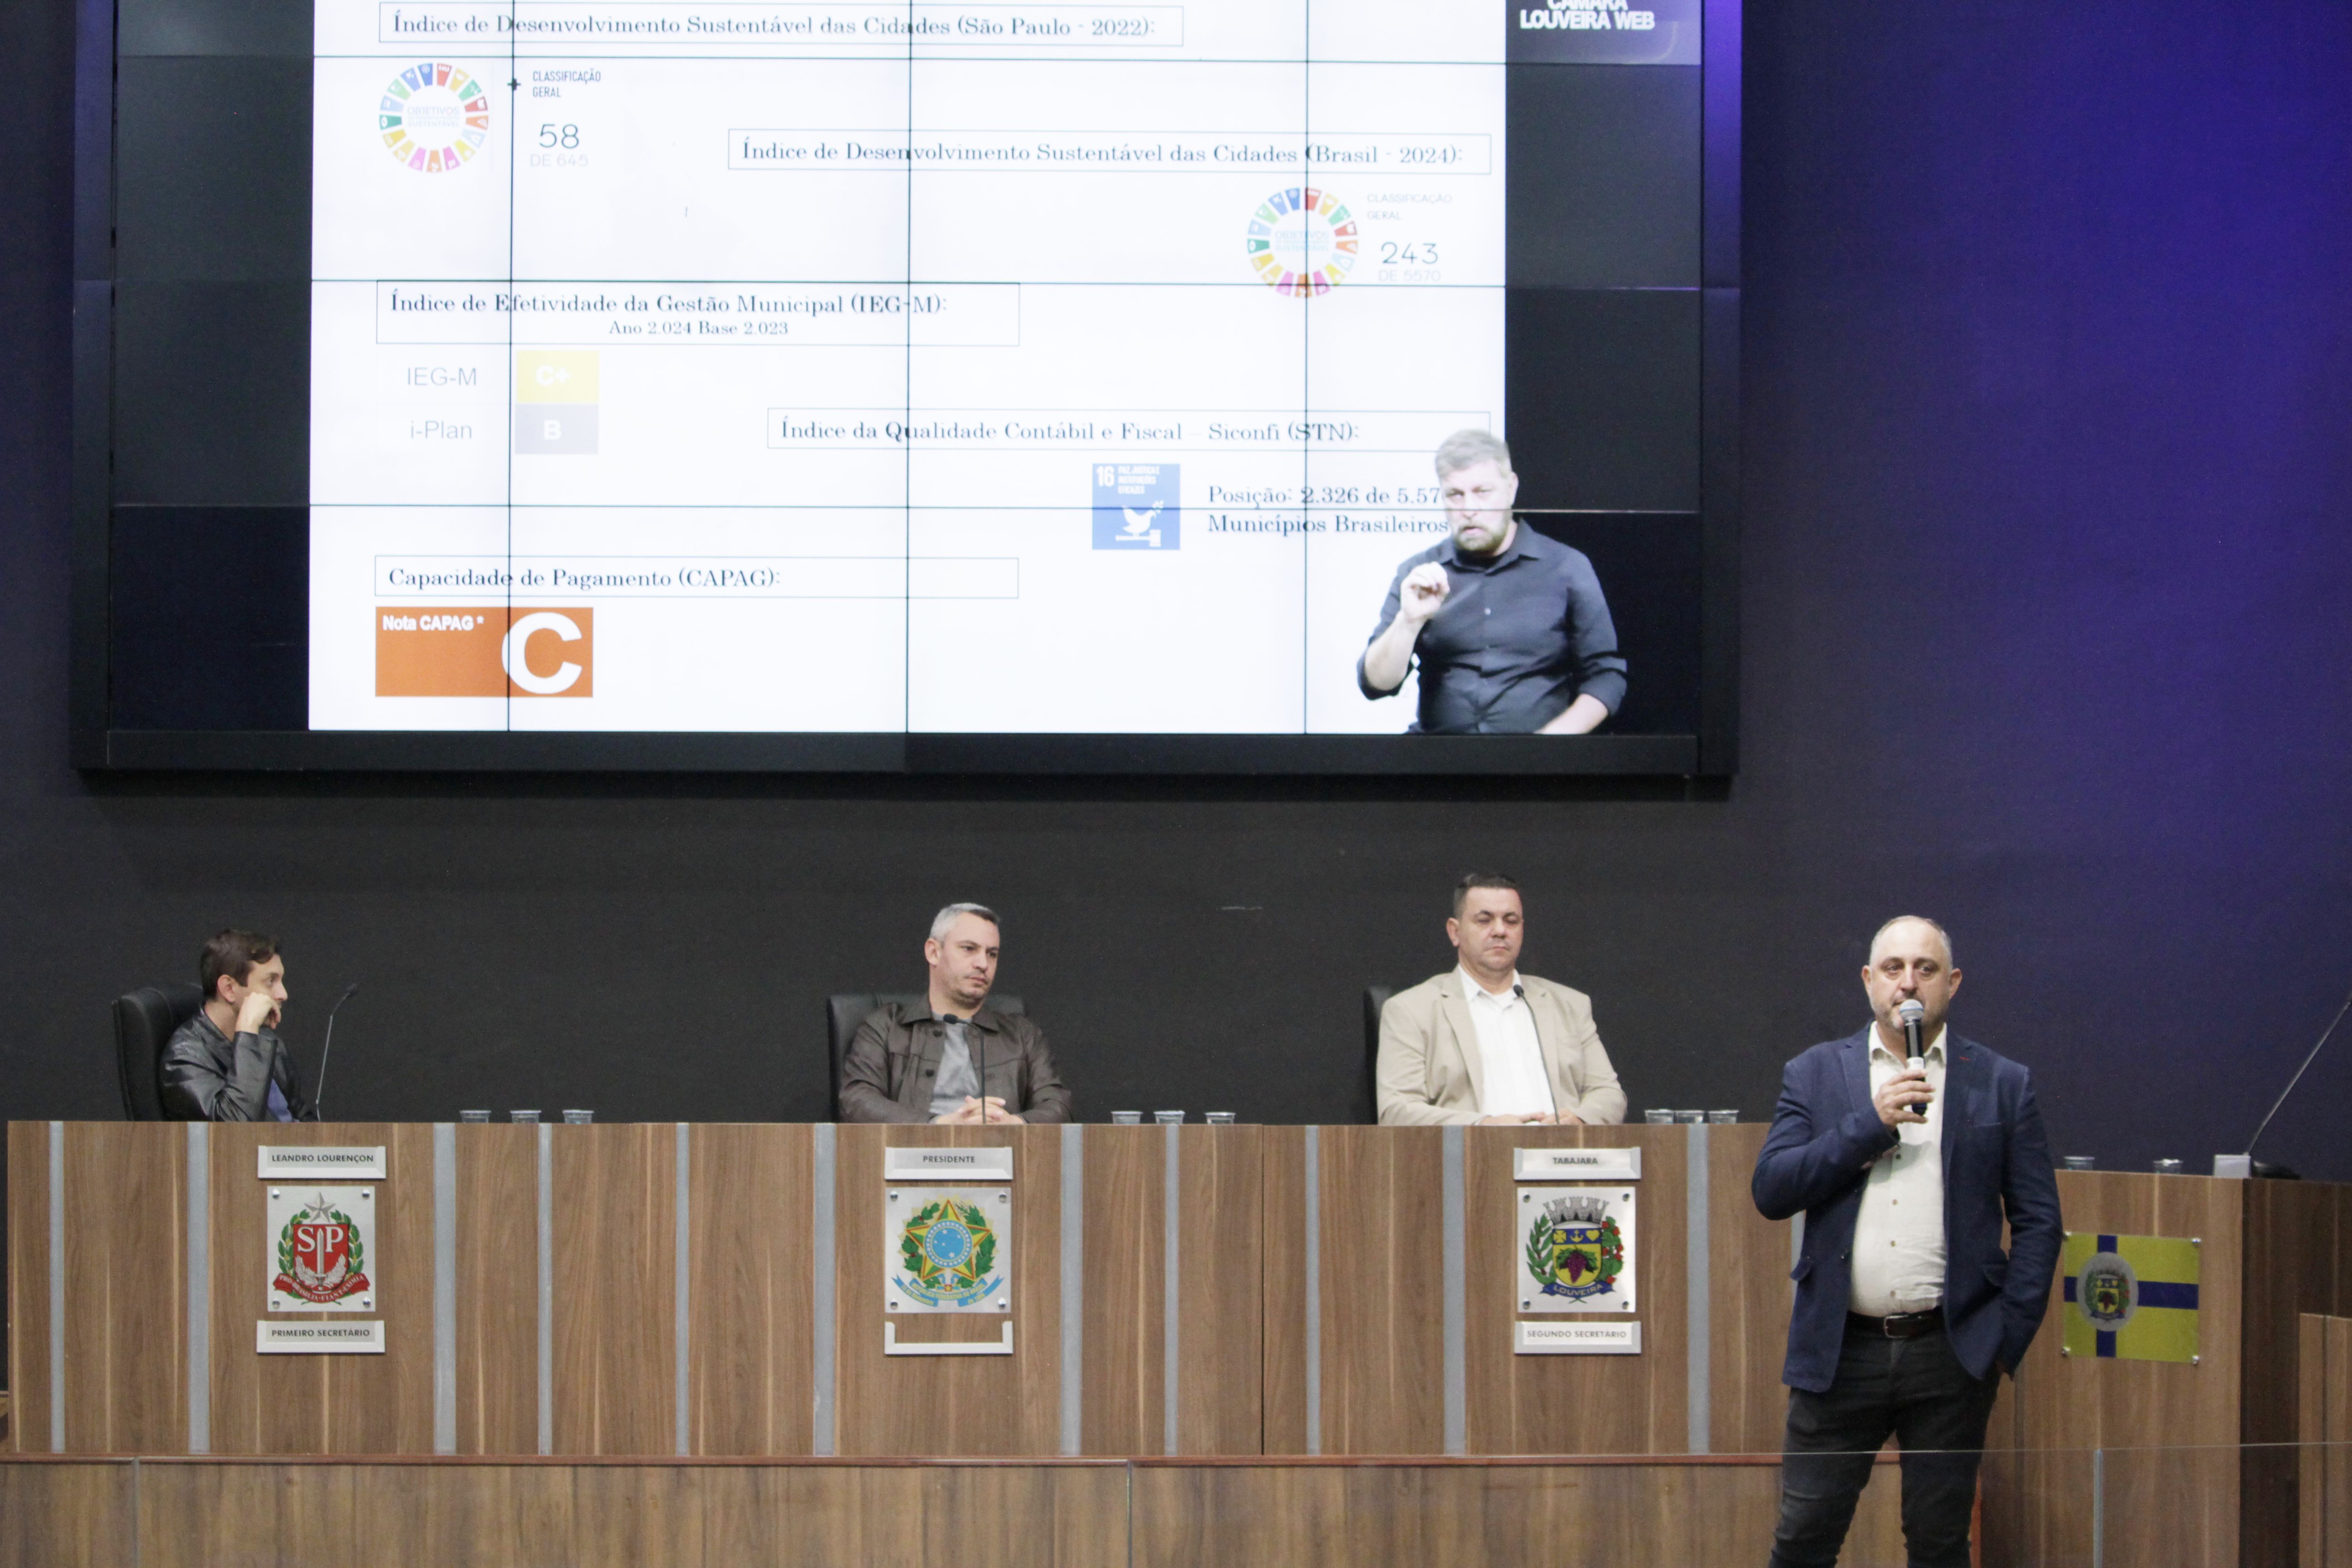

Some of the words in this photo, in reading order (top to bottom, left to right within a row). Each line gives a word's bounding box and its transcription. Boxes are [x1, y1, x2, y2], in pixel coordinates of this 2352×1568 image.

[394, 9, 458, 33] Índice
[465, 15, 489, 33] de
[496, 15, 680, 33] Desenvolvimento
[687, 15, 812, 33] Sustentável
[821, 16, 856, 33] das
[864, 16, 950, 34] Cidades
[957, 15, 1003, 35] (São
[1012, 18, 1071, 35] Paulo
[1092, 18, 1155, 36] 2022):
[1520, 10, 1611, 29] LOUVEIRA
[1614, 11, 1655, 30] WEB
[533, 68, 601, 84] CLASSIFICAÇÃO
[533, 86, 561, 98] GERAL
[539, 123, 579, 149] 58
[530, 153, 551, 167] DE
[557, 153, 588, 167] 645
[743, 136, 807, 159] Índice
[814, 142, 838, 159] de
[847, 142, 1030, 161] Desenvolvimento
[1037, 143, 1162, 162] Sustentável
[1170, 144, 1205, 162] das
[1213, 144, 1298, 162] Cidades
[1305, 144, 1377, 163] (Brasil
[1400, 145, 1462, 165] 2024):
[1367, 193, 1453, 205] CLASSIFICAÇÃO
[1367, 210, 1401, 220] GERAL
[1276, 230, 1329, 239] OBJETVOS
[1381, 241, 1438, 265] 243
[1378, 269, 1398, 282] DE
[1404, 270, 1441, 282] 5570
[392, 288, 456, 312] Índice
[462, 294, 486, 312] de
[495, 294, 617, 313] Efetividade
[624, 294, 648, 312] da
[657, 295, 730, 312] Gestão
[737, 295, 843, 317] Municipal
[851, 293, 947, 314] (IEG-M):
[609, 320, 642, 334] Ano
[648, 321, 692, 335] 2.024
[699, 321, 738, 335] Base
[744, 322, 789, 335] 2.023
[407, 367, 477, 386] IEG-M
[535, 366, 570, 387] C+
[411, 420, 472, 439] i-Plan
[544, 420, 562, 440] B
[783, 416, 846, 438] Índice
[853, 421, 877, 438] da
[885, 421, 997, 442] Qualidade
[1004, 421, 1093, 440] Contábil
[1102, 429, 1112, 439] e
[1122, 422, 1181, 440] Fiscal
[1209, 422, 1279, 441] Siconfi
[1288, 422, 1359, 443] (STN):
[1096, 466, 1115, 487] 16
[1209, 485, 1292, 509] Posição:
[1300, 486, 1360, 504] 2.326
[1366, 486, 1390, 504] de
[1397, 487, 1440, 504] 5.57
[1208, 514, 1327, 537] Municípios
[1335, 514, 1449, 533] Brasileiros
[389, 568, 513, 588] Capacidade
[521, 568, 544, 586] de
[553, 568, 671, 589] Pagamento
[678, 567, 781, 588] (CAPAG):
[383, 615, 416, 631] Nota
[420, 615, 474, 631] CAPAG
[502, 612, 582, 694] C
[317, 1155, 373, 1163] LOURENÇON
[1552, 1157, 1598, 1165] TABAJARA
[1553, 1284, 1603, 1296] LOUVEIRA
